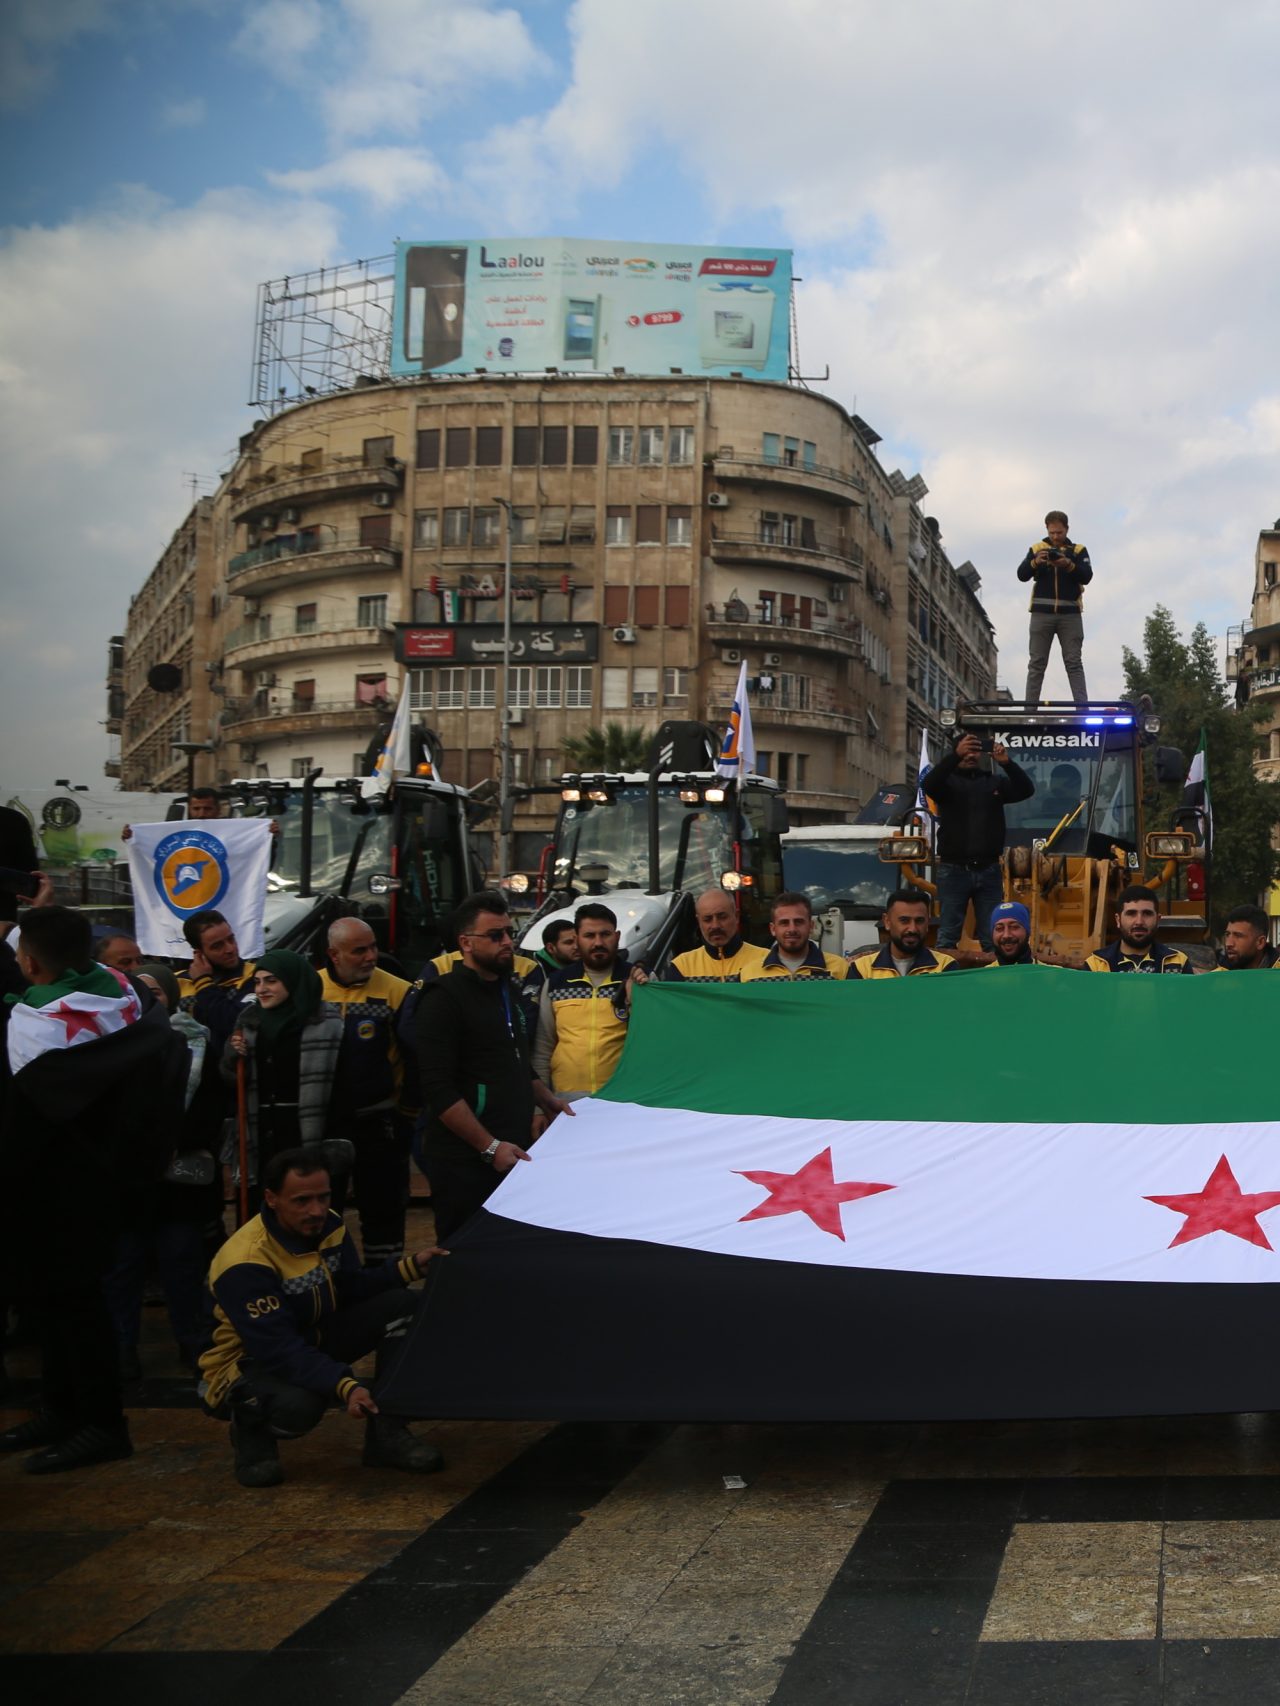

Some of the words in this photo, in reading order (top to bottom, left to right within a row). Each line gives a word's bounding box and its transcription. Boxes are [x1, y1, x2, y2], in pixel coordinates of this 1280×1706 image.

[480, 246, 545, 269] Laalou
[651, 313, 674, 323] 9799
[531, 628, 588, 657] شركة
[994, 731, 1100, 748] Kawasaki
[622, 789, 676, 797] ALHA
[246, 1295, 281, 1319] SCD
